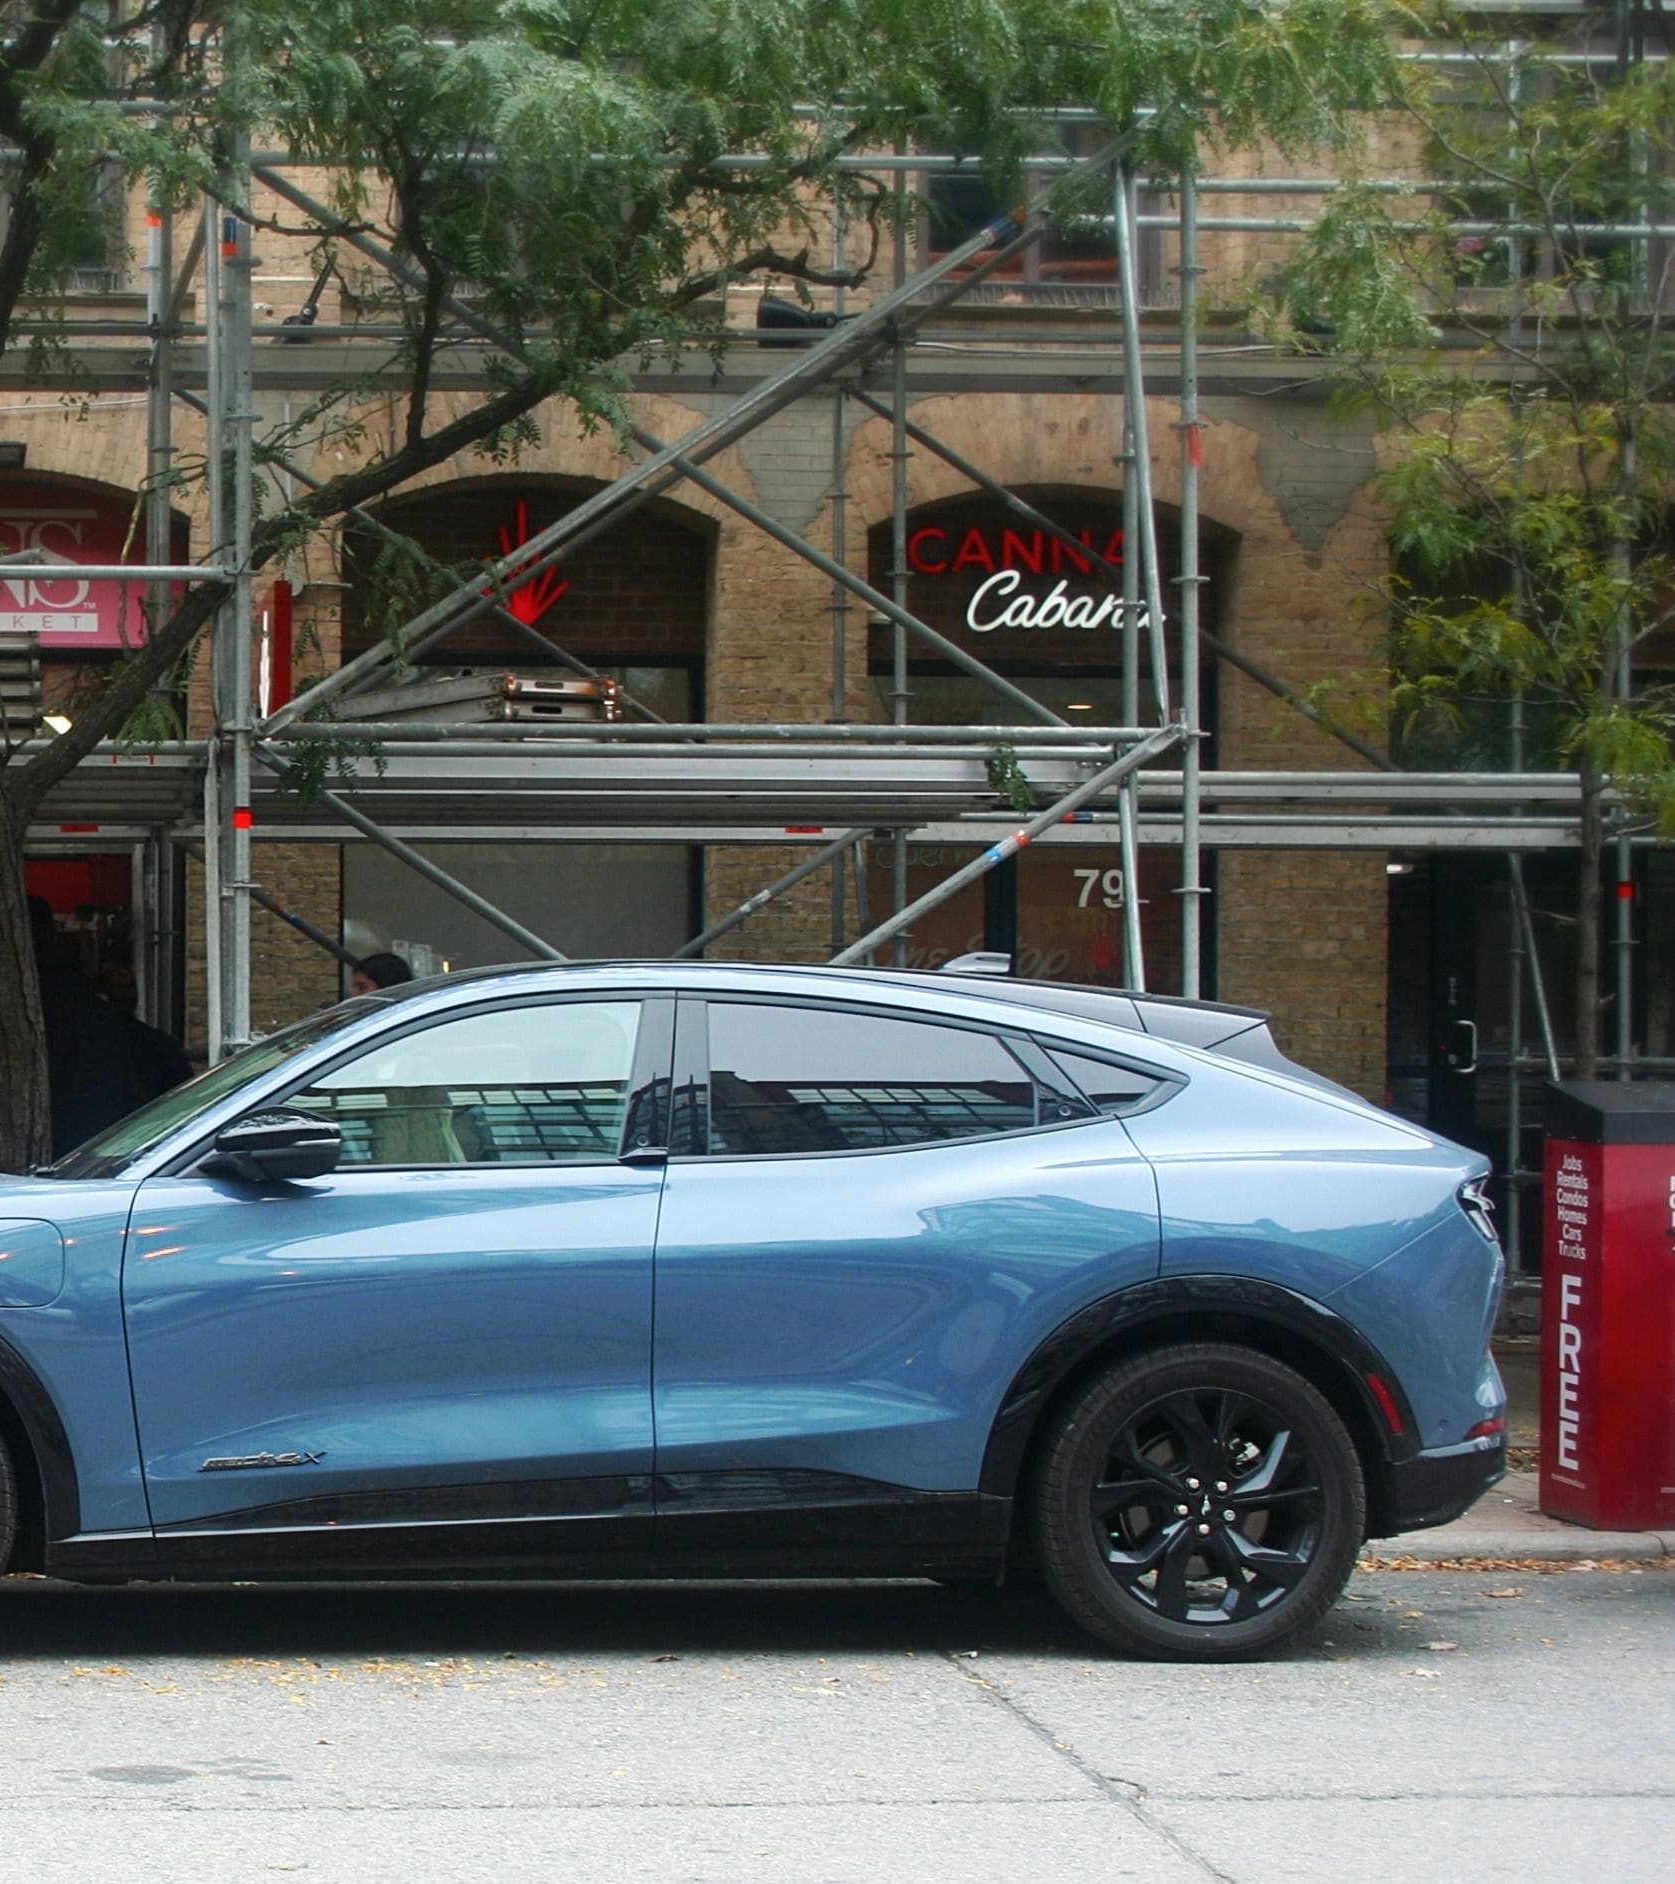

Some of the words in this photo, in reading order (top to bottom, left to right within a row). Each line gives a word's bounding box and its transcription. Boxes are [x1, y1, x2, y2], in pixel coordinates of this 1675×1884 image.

[1563, 1154, 1582, 1172] Jobs
[1557, 1170, 1588, 1190] Rentals
[1557, 1187, 1588, 1208] Condos
[1558, 1205, 1587, 1225] Homes
[1563, 1223, 1582, 1242] Cars
[1558, 1240, 1586, 1260] Trucks
[1558, 1274, 1582, 1471] FREE
